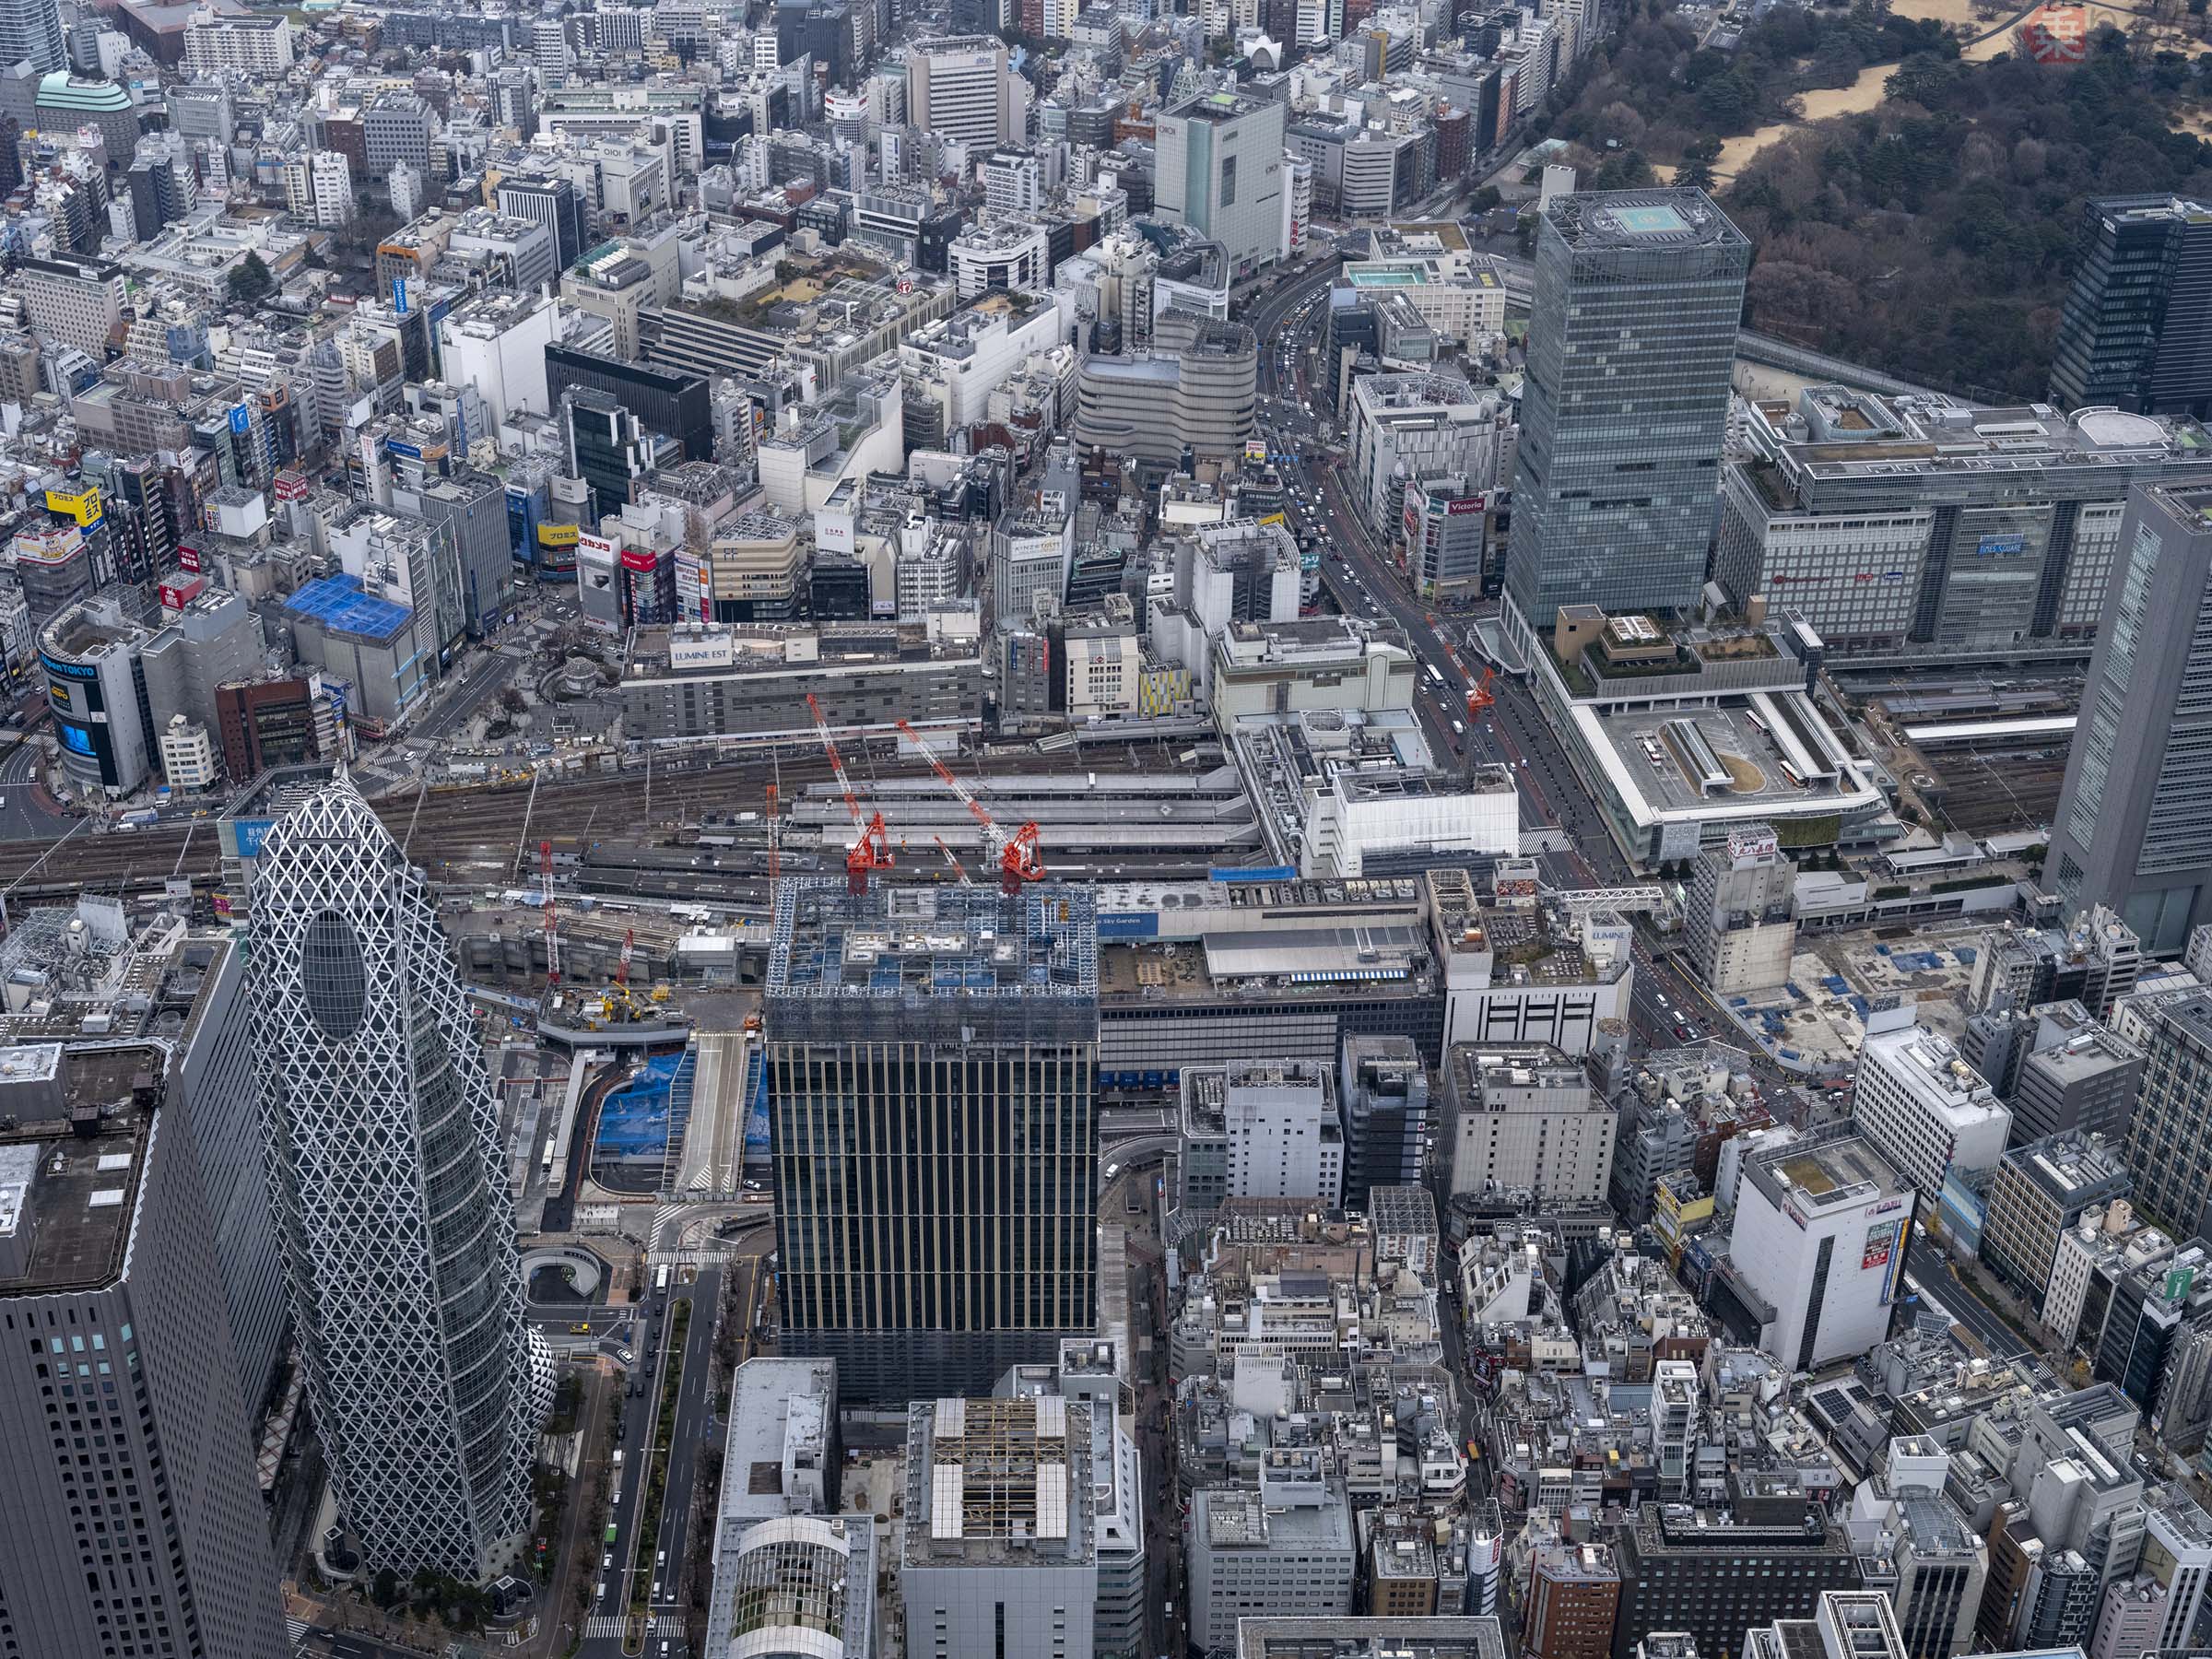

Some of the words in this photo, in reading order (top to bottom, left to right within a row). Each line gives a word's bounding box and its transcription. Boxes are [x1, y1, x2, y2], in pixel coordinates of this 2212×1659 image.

[53, 493, 74, 502] プロミス
[1452, 501, 1482, 512] Victoria
[550, 531, 577, 540] プロミス
[675, 651, 712, 662] LUMINE
[712, 650, 728, 658] EST
[62, 664, 94, 677] TOKYO
[1593, 931, 1626, 941] LUMINE
